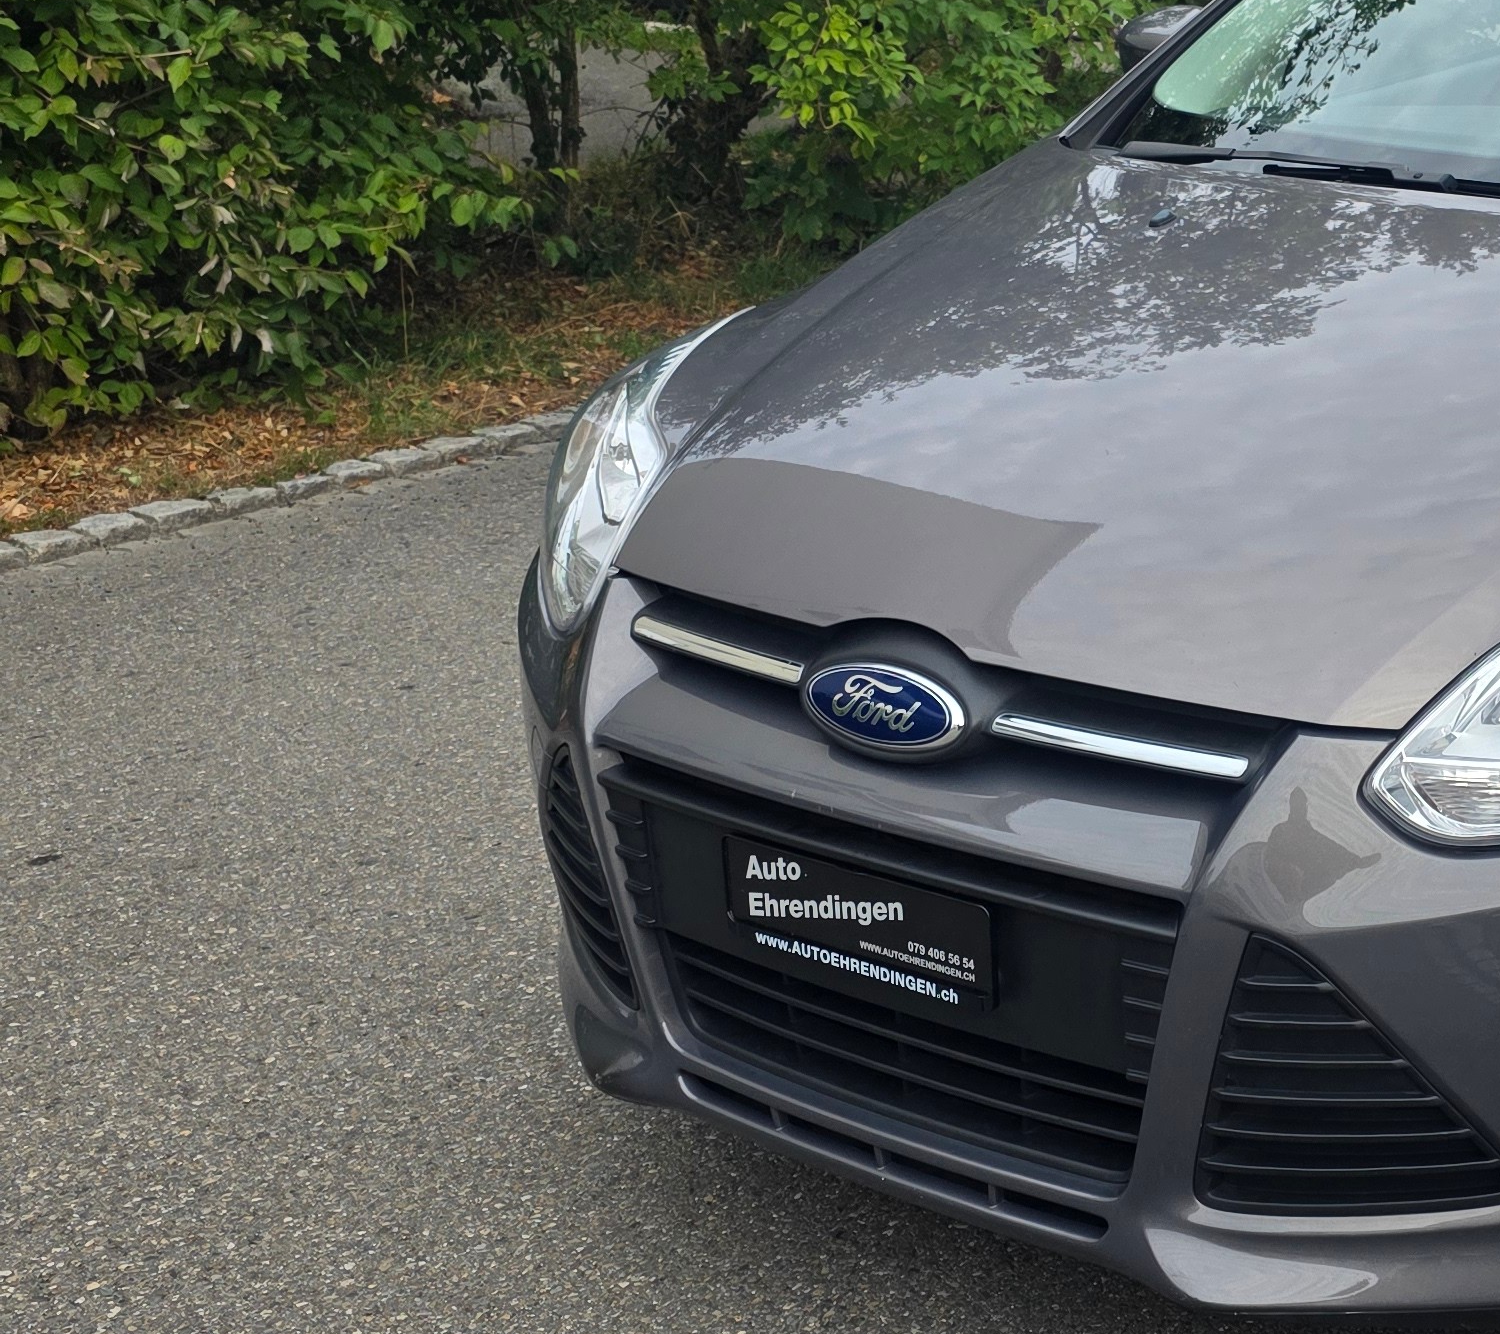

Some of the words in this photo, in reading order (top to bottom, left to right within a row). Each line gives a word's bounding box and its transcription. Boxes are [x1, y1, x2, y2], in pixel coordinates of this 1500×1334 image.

[831, 674, 922, 733] Ford
[746, 855, 801, 880] Auto
[748, 892, 904, 925] Ehrendingen
[755, 932, 959, 1004] www.AUTOEHRENDINGEN.ch
[907, 941, 925, 955] 079
[927, 947, 945, 961] 406
[947, 953, 960, 966] 56
[962, 958, 974, 970] 54
